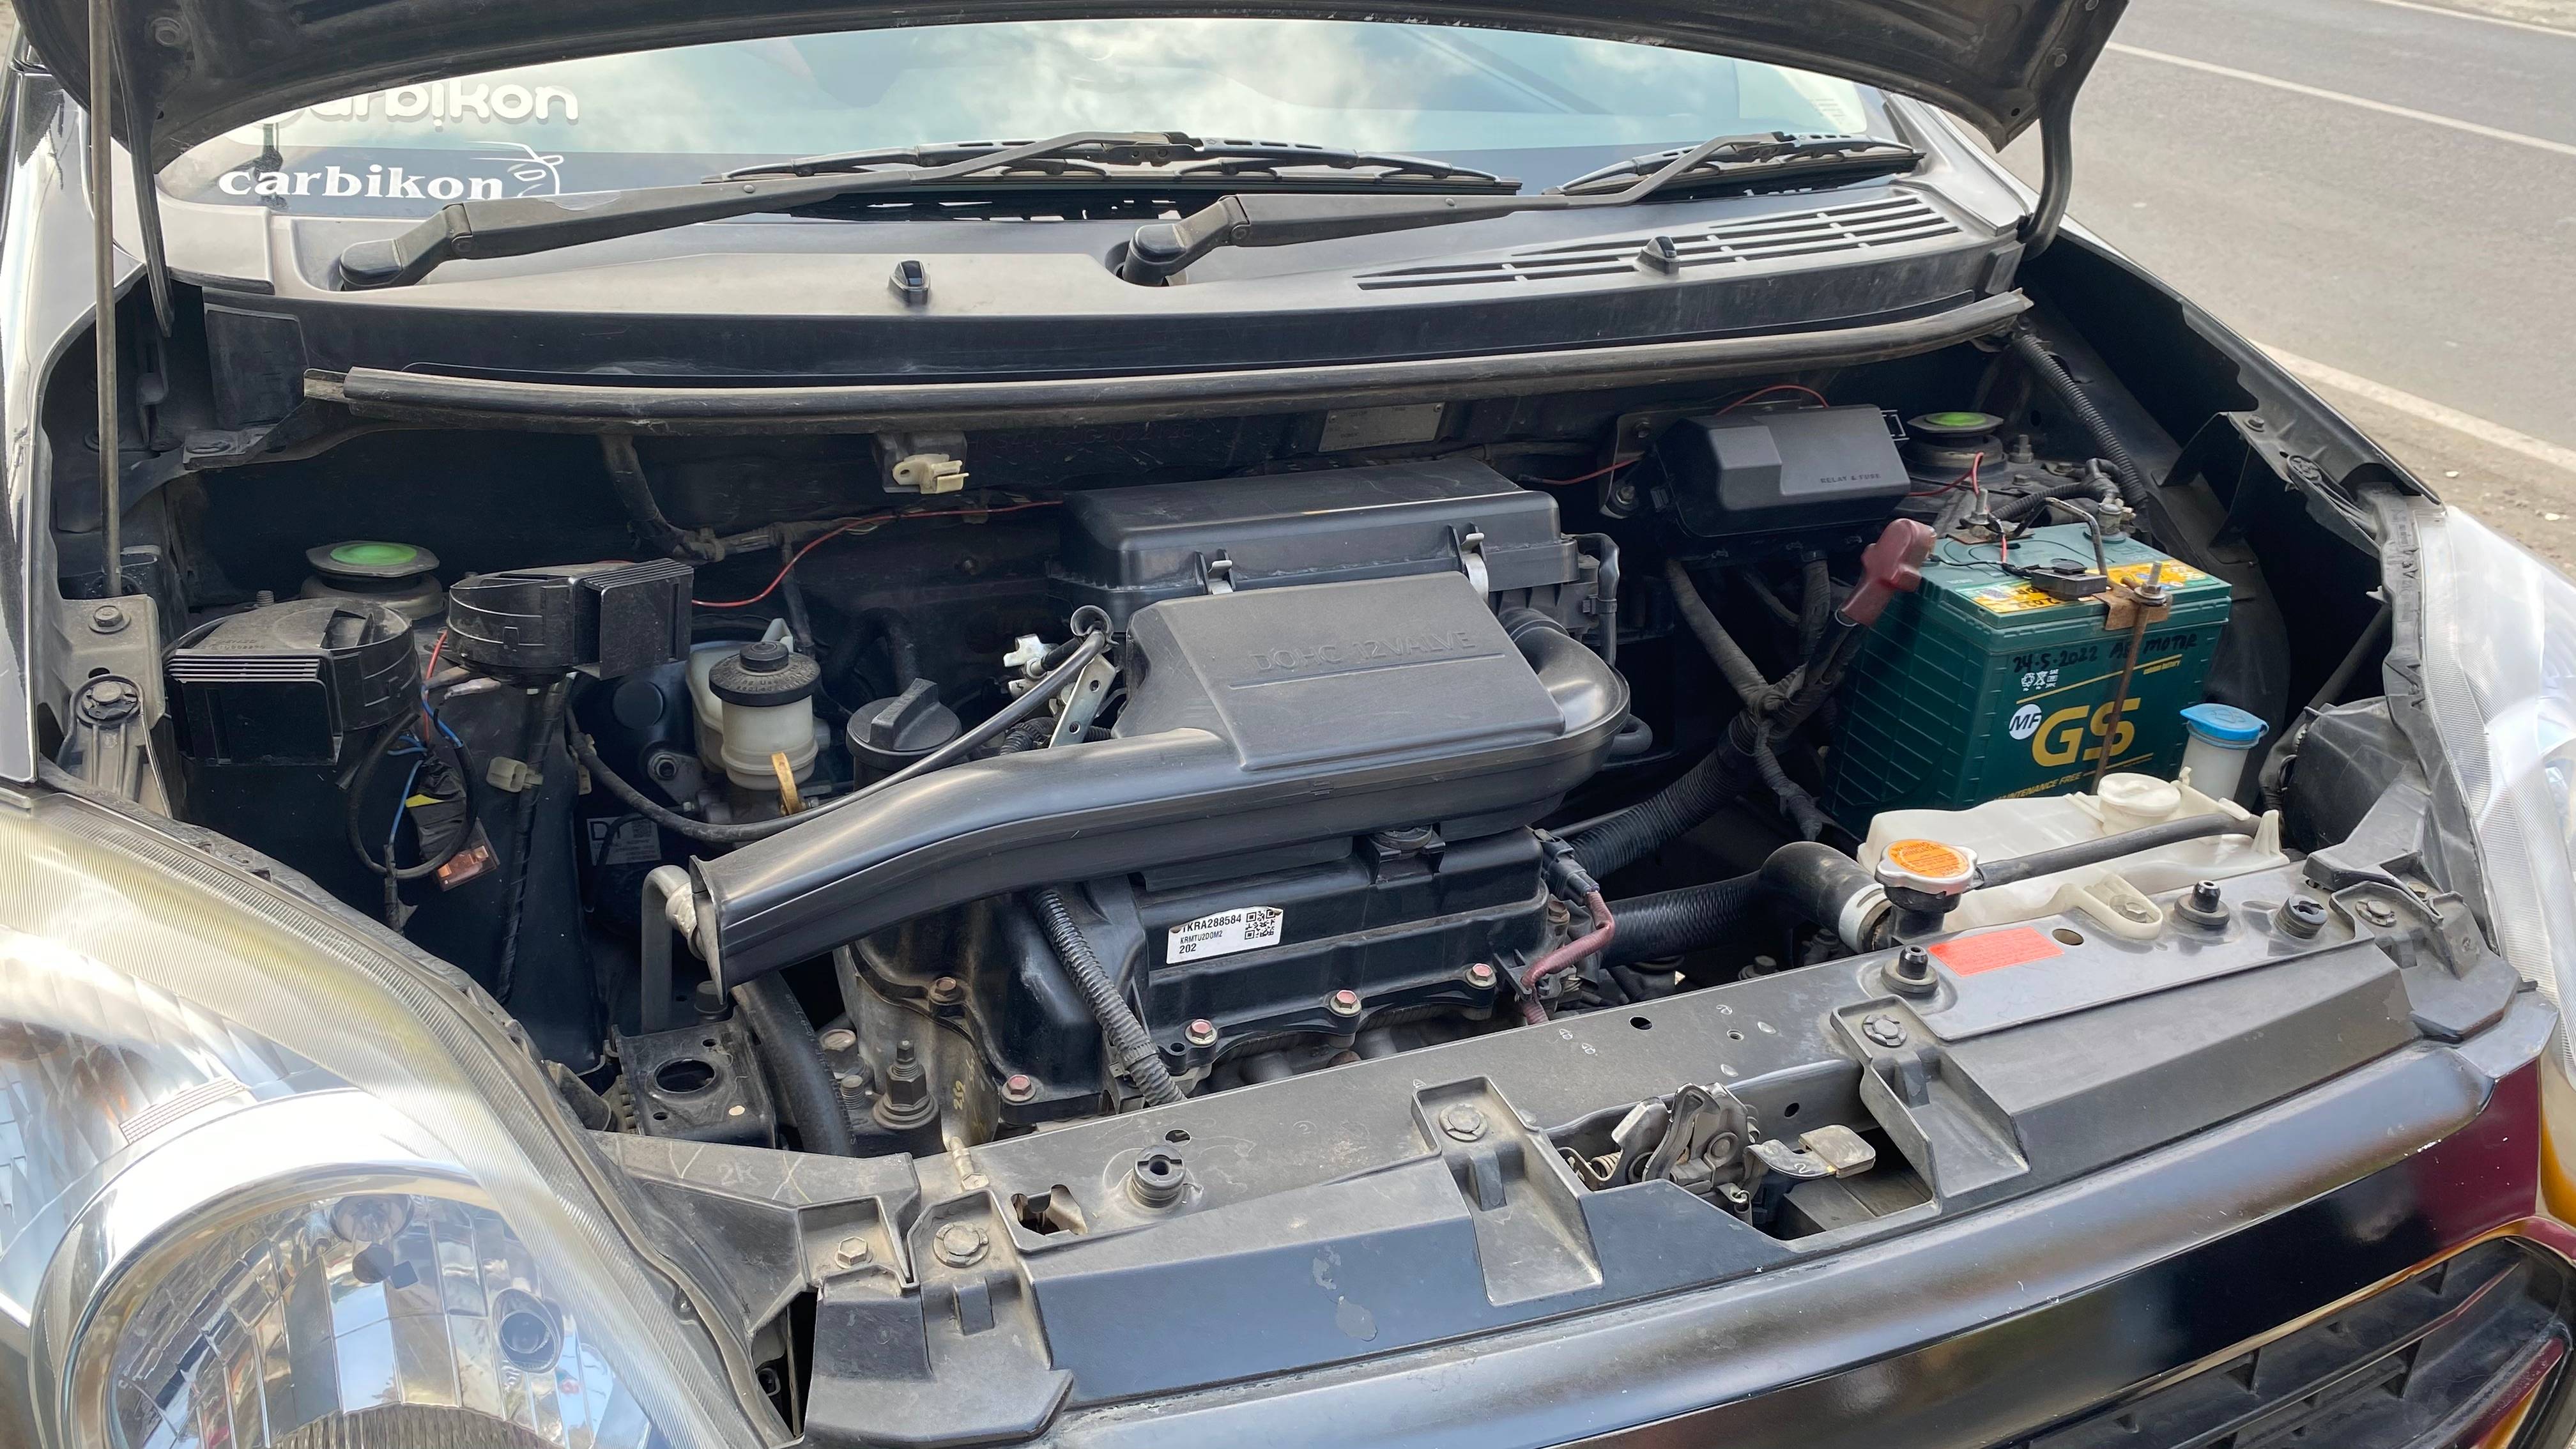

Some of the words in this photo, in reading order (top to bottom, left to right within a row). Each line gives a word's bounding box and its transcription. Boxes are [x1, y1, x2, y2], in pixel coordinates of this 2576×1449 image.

[218, 164, 504, 201] carbikon
[1820, 475, 1848, 484] RELAY
[2142, 633, 2198, 655] MOTOR
[1248, 643, 1344, 673] DOHC
[2009, 712, 2043, 732] MF
[2032, 697, 2142, 767] GS
[2058, 770, 2083, 786] FREE
[1179, 943, 1197, 954] 202
